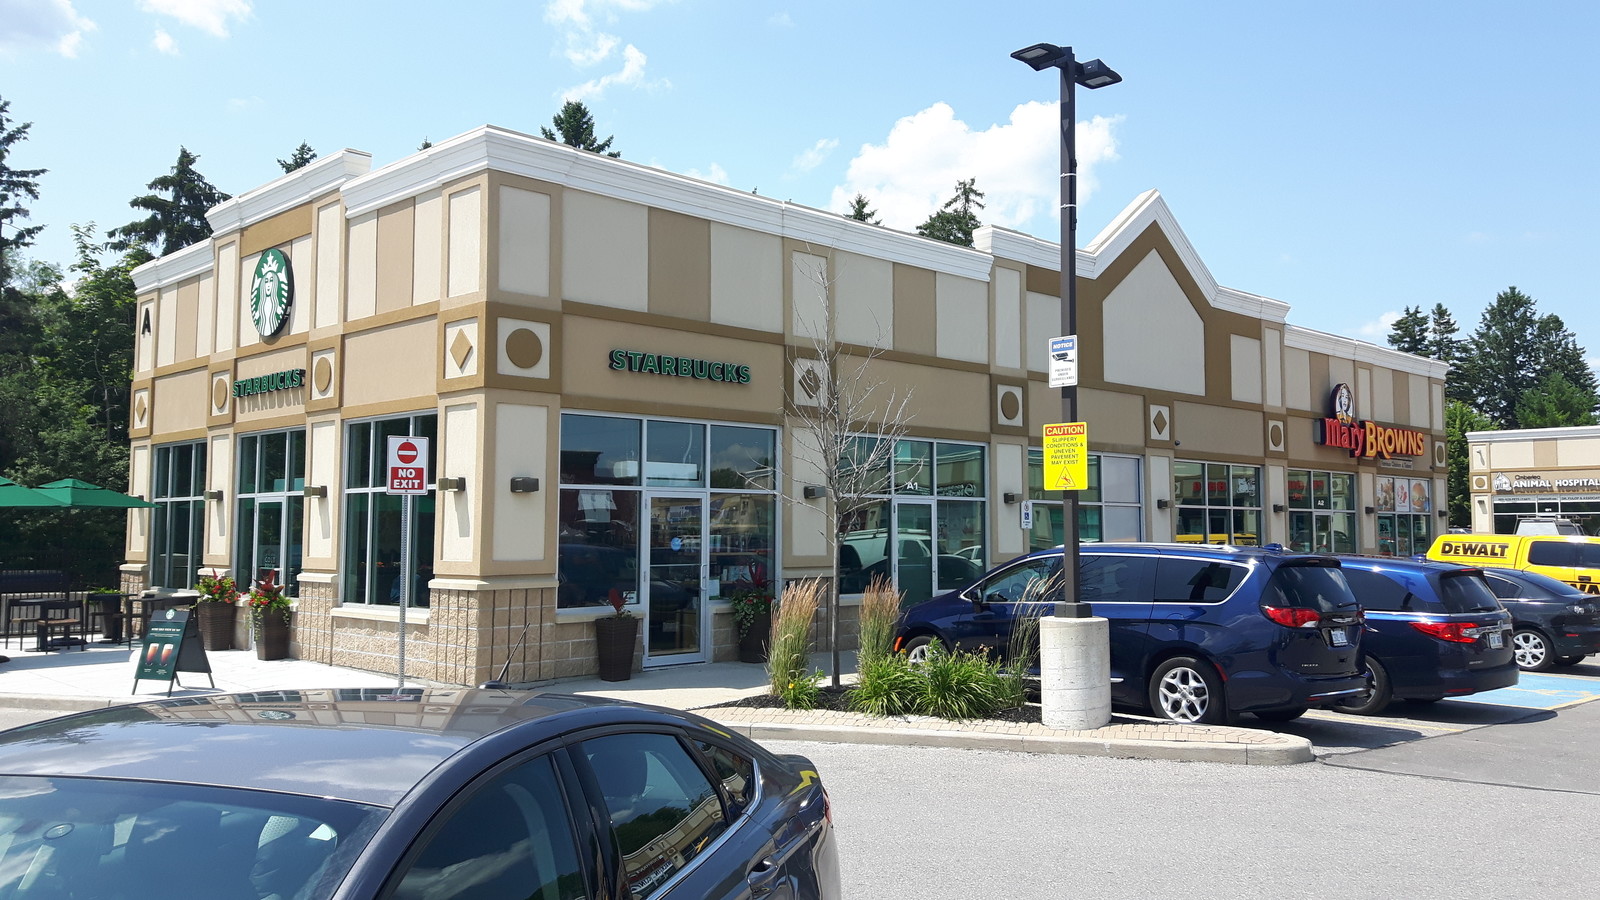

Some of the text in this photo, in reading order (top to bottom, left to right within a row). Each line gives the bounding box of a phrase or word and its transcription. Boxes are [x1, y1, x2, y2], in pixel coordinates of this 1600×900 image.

[141, 307, 151, 335] A
[609, 349, 751, 384] STARBUCKS
[232, 368, 304, 398] STARBUCKS
[1046, 426, 1083, 435] CAUTION
[1365, 421, 1424, 459] BROWNS
[398, 468, 416, 478] NO
[393, 479, 420, 489] EXIT
[907, 482, 918, 490] A1
[1512, 478, 1600, 488] ANIMAL HOSPITAL
